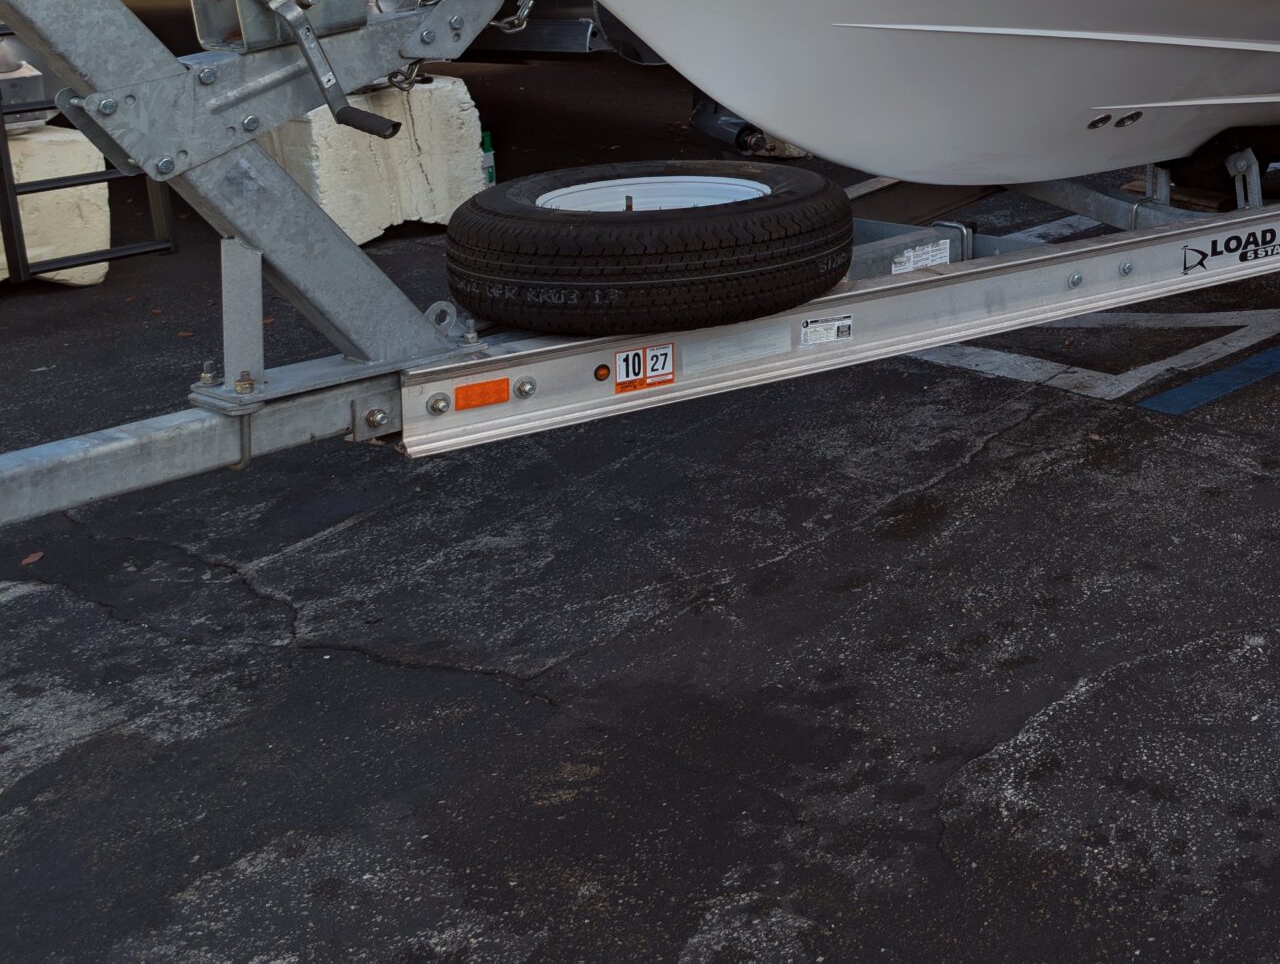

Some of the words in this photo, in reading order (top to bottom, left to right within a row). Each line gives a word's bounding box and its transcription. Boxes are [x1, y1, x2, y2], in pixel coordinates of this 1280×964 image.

[1210, 228, 1277, 257] LOAD
[1246, 250, 1255, 260] 5
[623, 352, 641, 378] 10
[650, 352, 668, 372] 27
